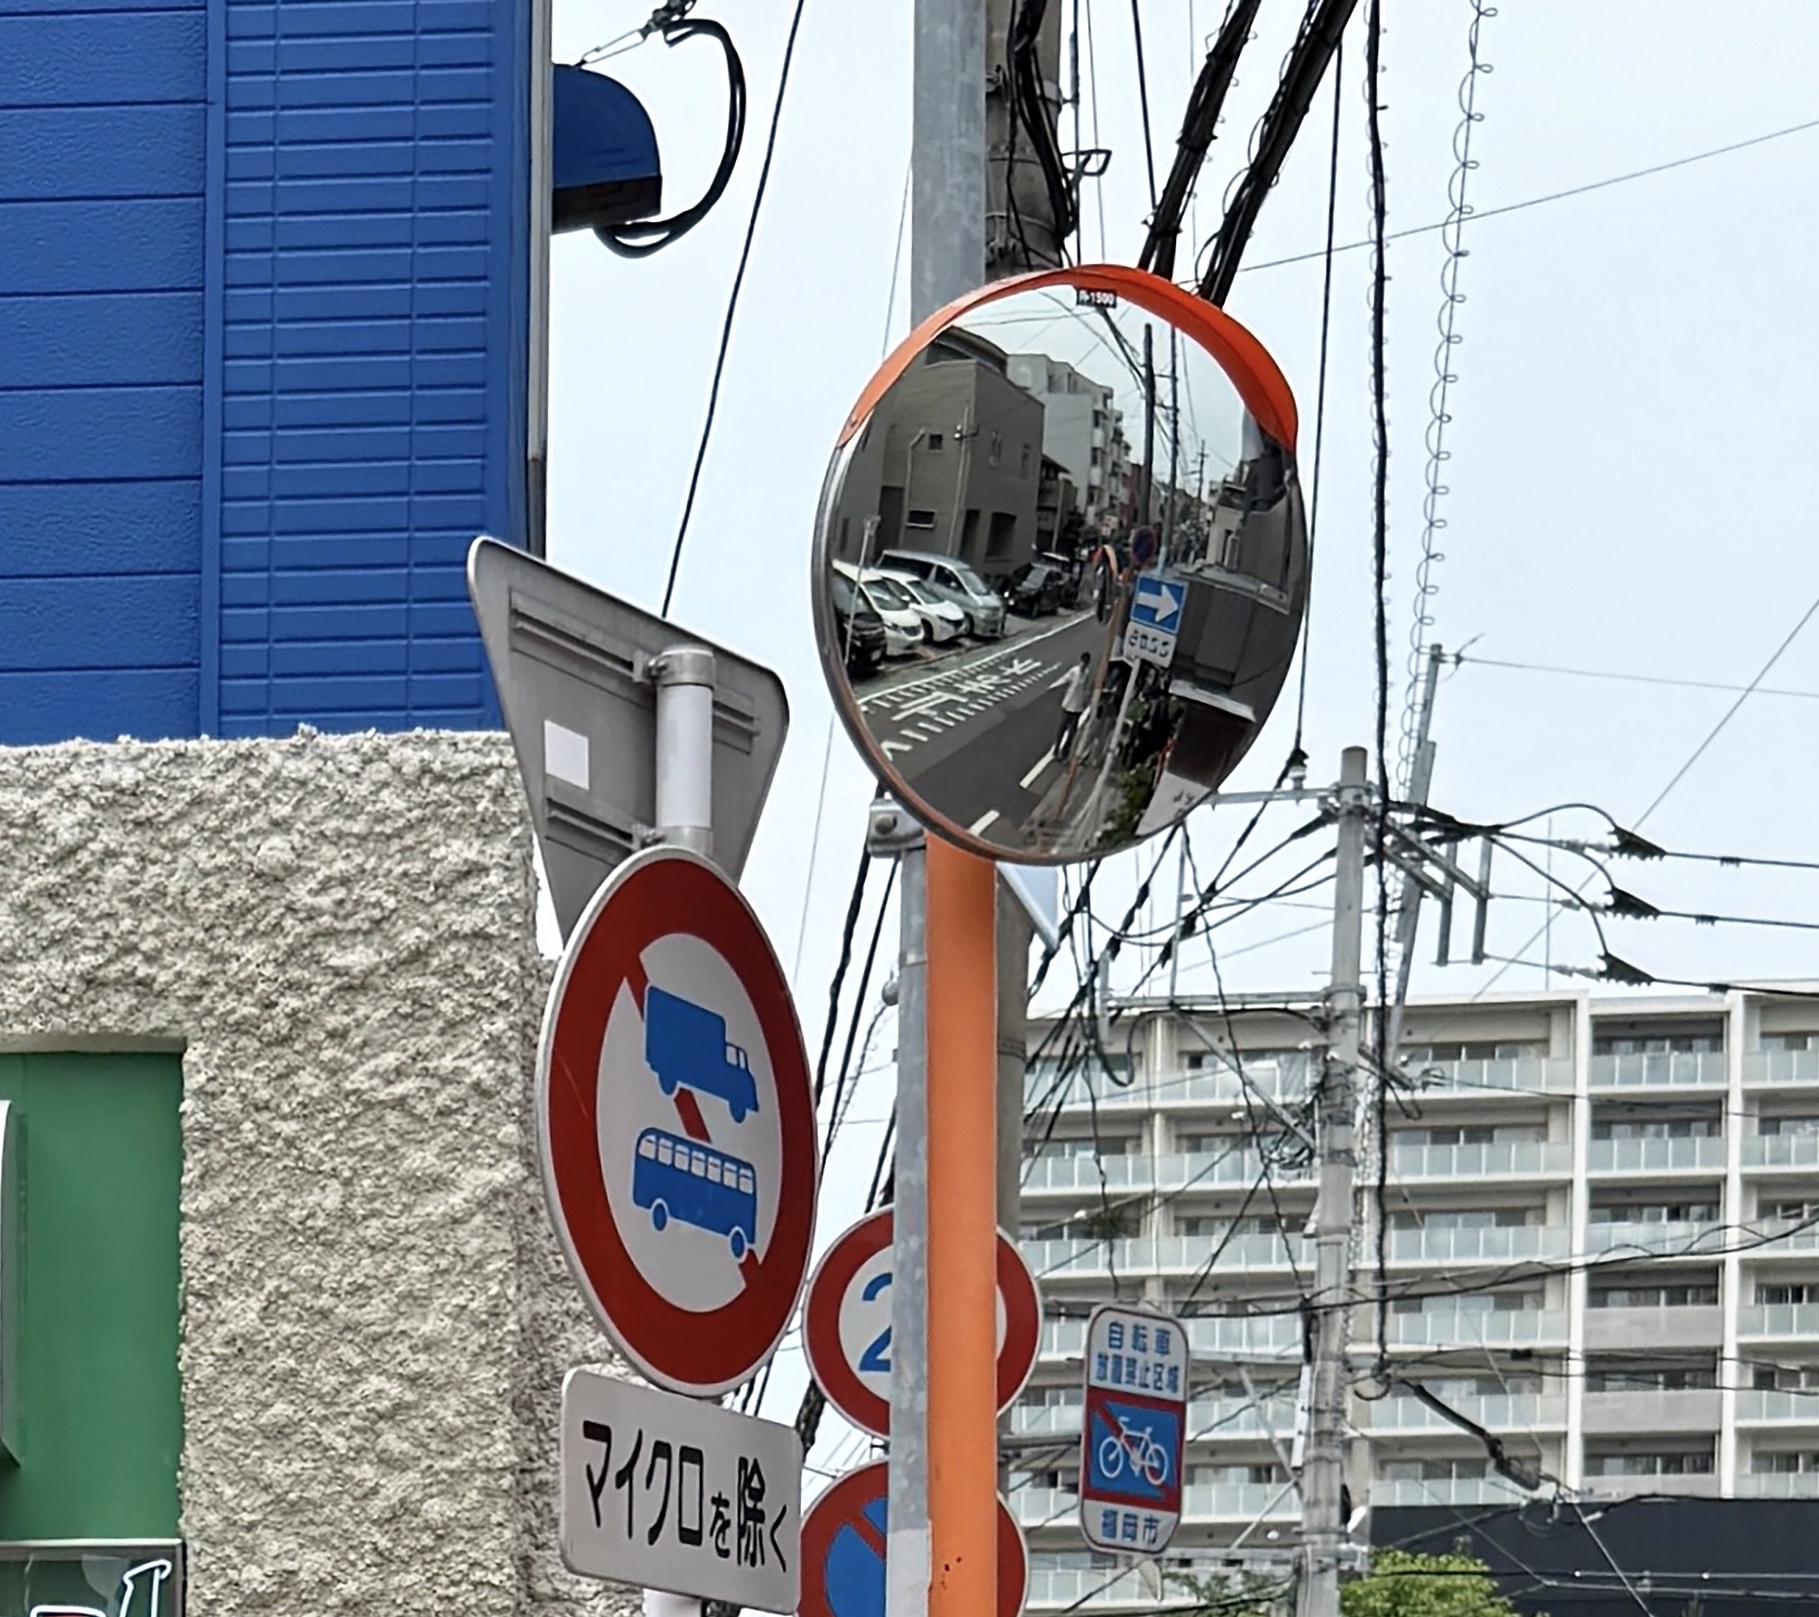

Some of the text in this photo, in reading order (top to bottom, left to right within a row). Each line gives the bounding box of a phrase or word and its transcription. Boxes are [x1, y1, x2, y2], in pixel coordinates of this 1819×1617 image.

[1108, 1321, 1171, 1355] 自転車
[583, 1420, 787, 1573] マイクロを除く
[1100, 1508, 1160, 1545] 福岡市
